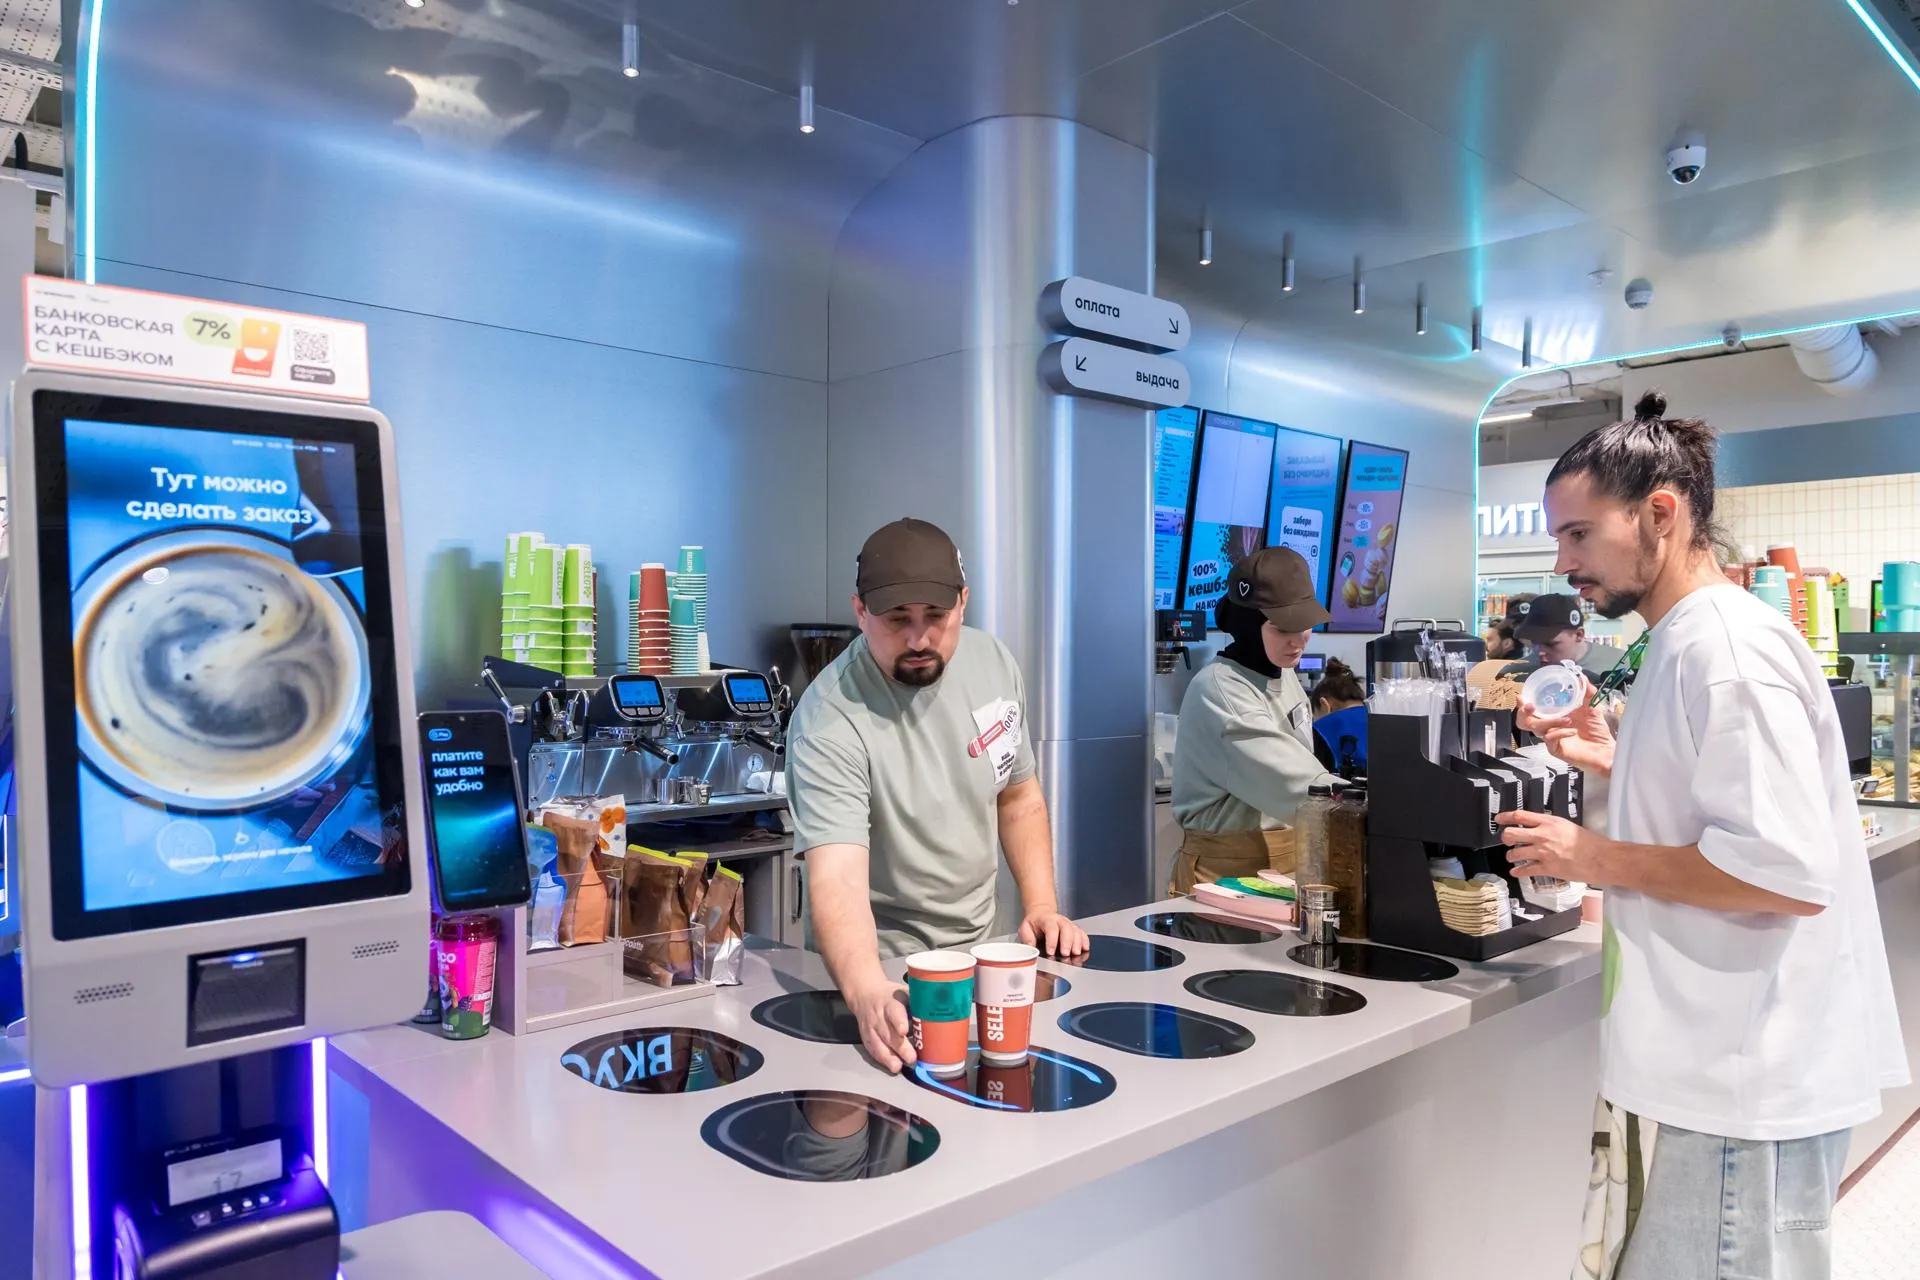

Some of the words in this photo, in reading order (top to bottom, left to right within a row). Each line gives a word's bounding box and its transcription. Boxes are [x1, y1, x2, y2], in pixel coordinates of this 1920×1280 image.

[1075, 297, 1120, 318] оплата
[34, 305, 174, 335] БАНКОВСКАЯ
[192, 318, 231, 340] 7%
[35, 323, 101, 341] КАРТА
[35, 339, 50, 352] С
[56, 341, 174, 366] КЕШБЭКОМ
[1136, 371, 1179, 390] выдача
[150, 467, 197, 493] Тут
[203, 475, 287, 495] можно
[126, 501, 236, 520] сделать
[242, 506, 313, 524] заказ
[1192, 562, 1217, 577] 100%
[431, 751, 484, 762] платите
[433, 767, 457, 778] как
[459, 766, 484, 776] вам
[435, 780, 483, 796] удобно
